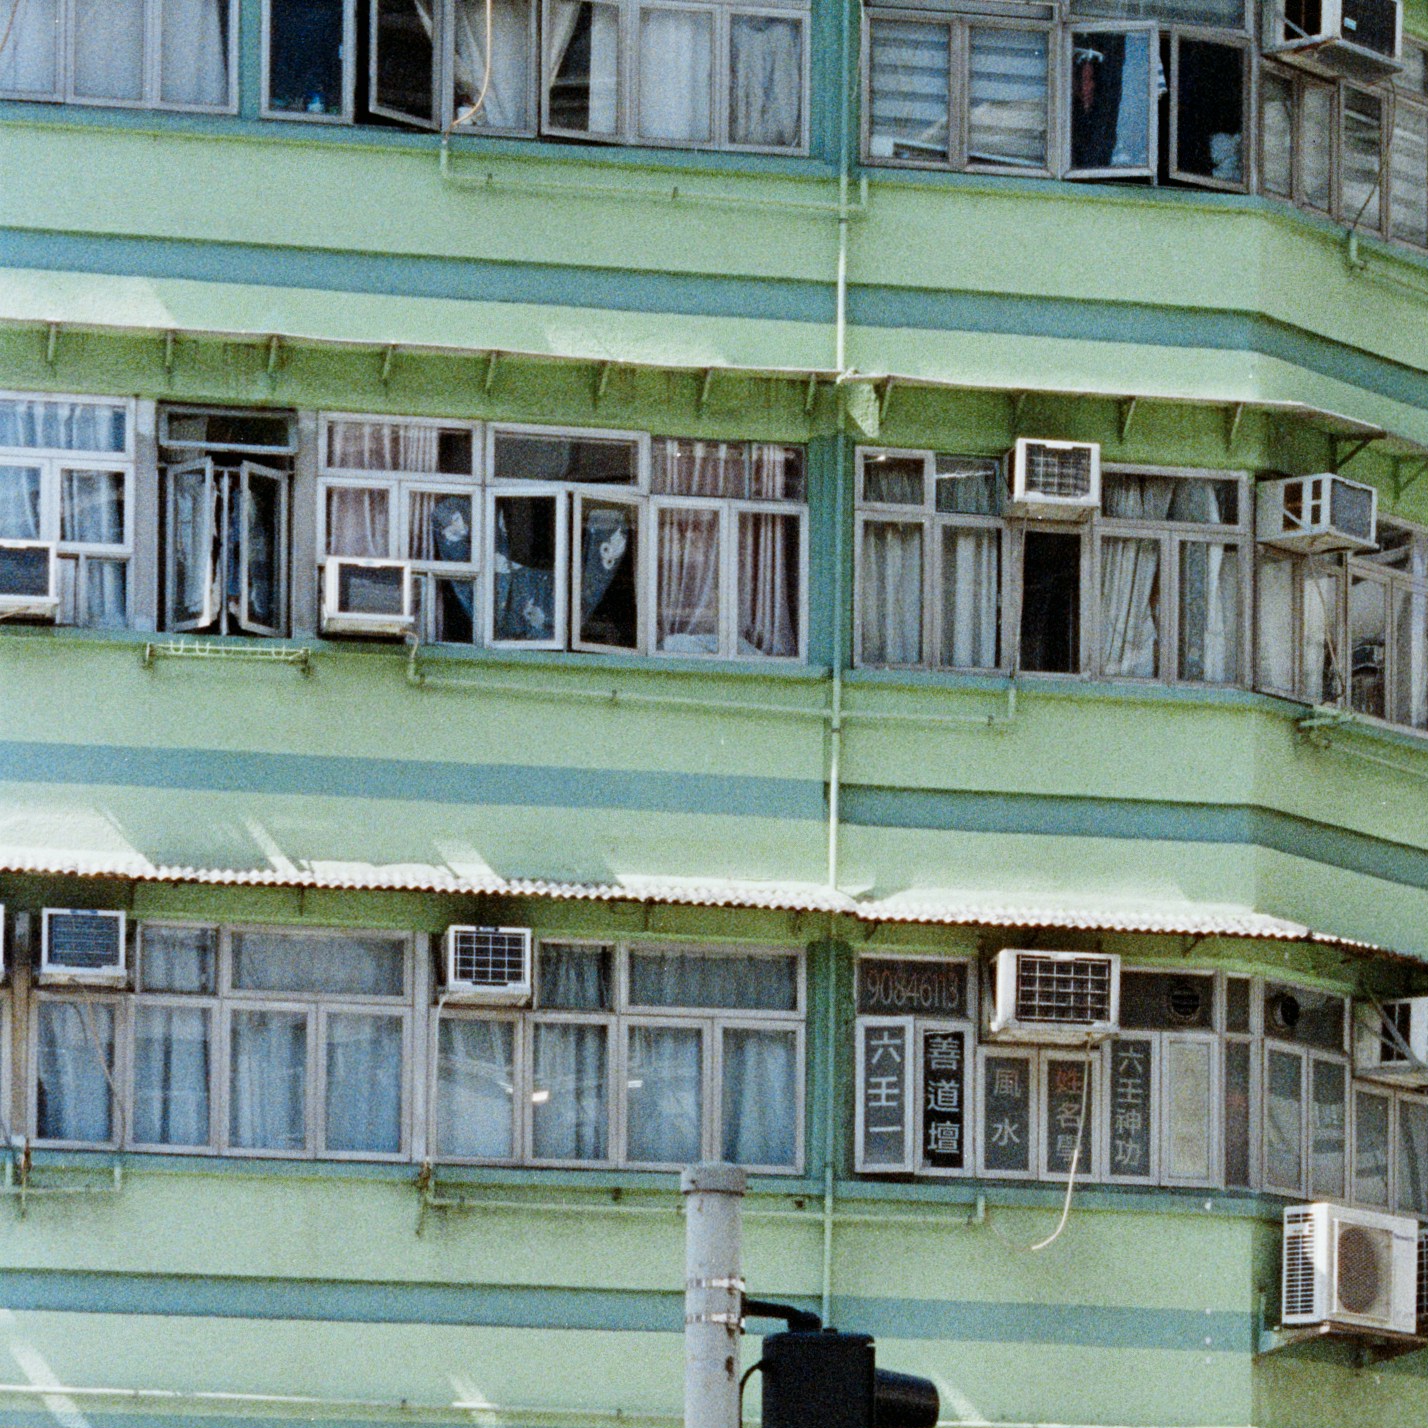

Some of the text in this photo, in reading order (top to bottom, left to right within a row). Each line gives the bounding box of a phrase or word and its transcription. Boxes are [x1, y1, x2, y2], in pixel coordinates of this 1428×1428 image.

[927, 1036, 961, 1154] 善道壇
[992, 1069, 1021, 1146] 風水
